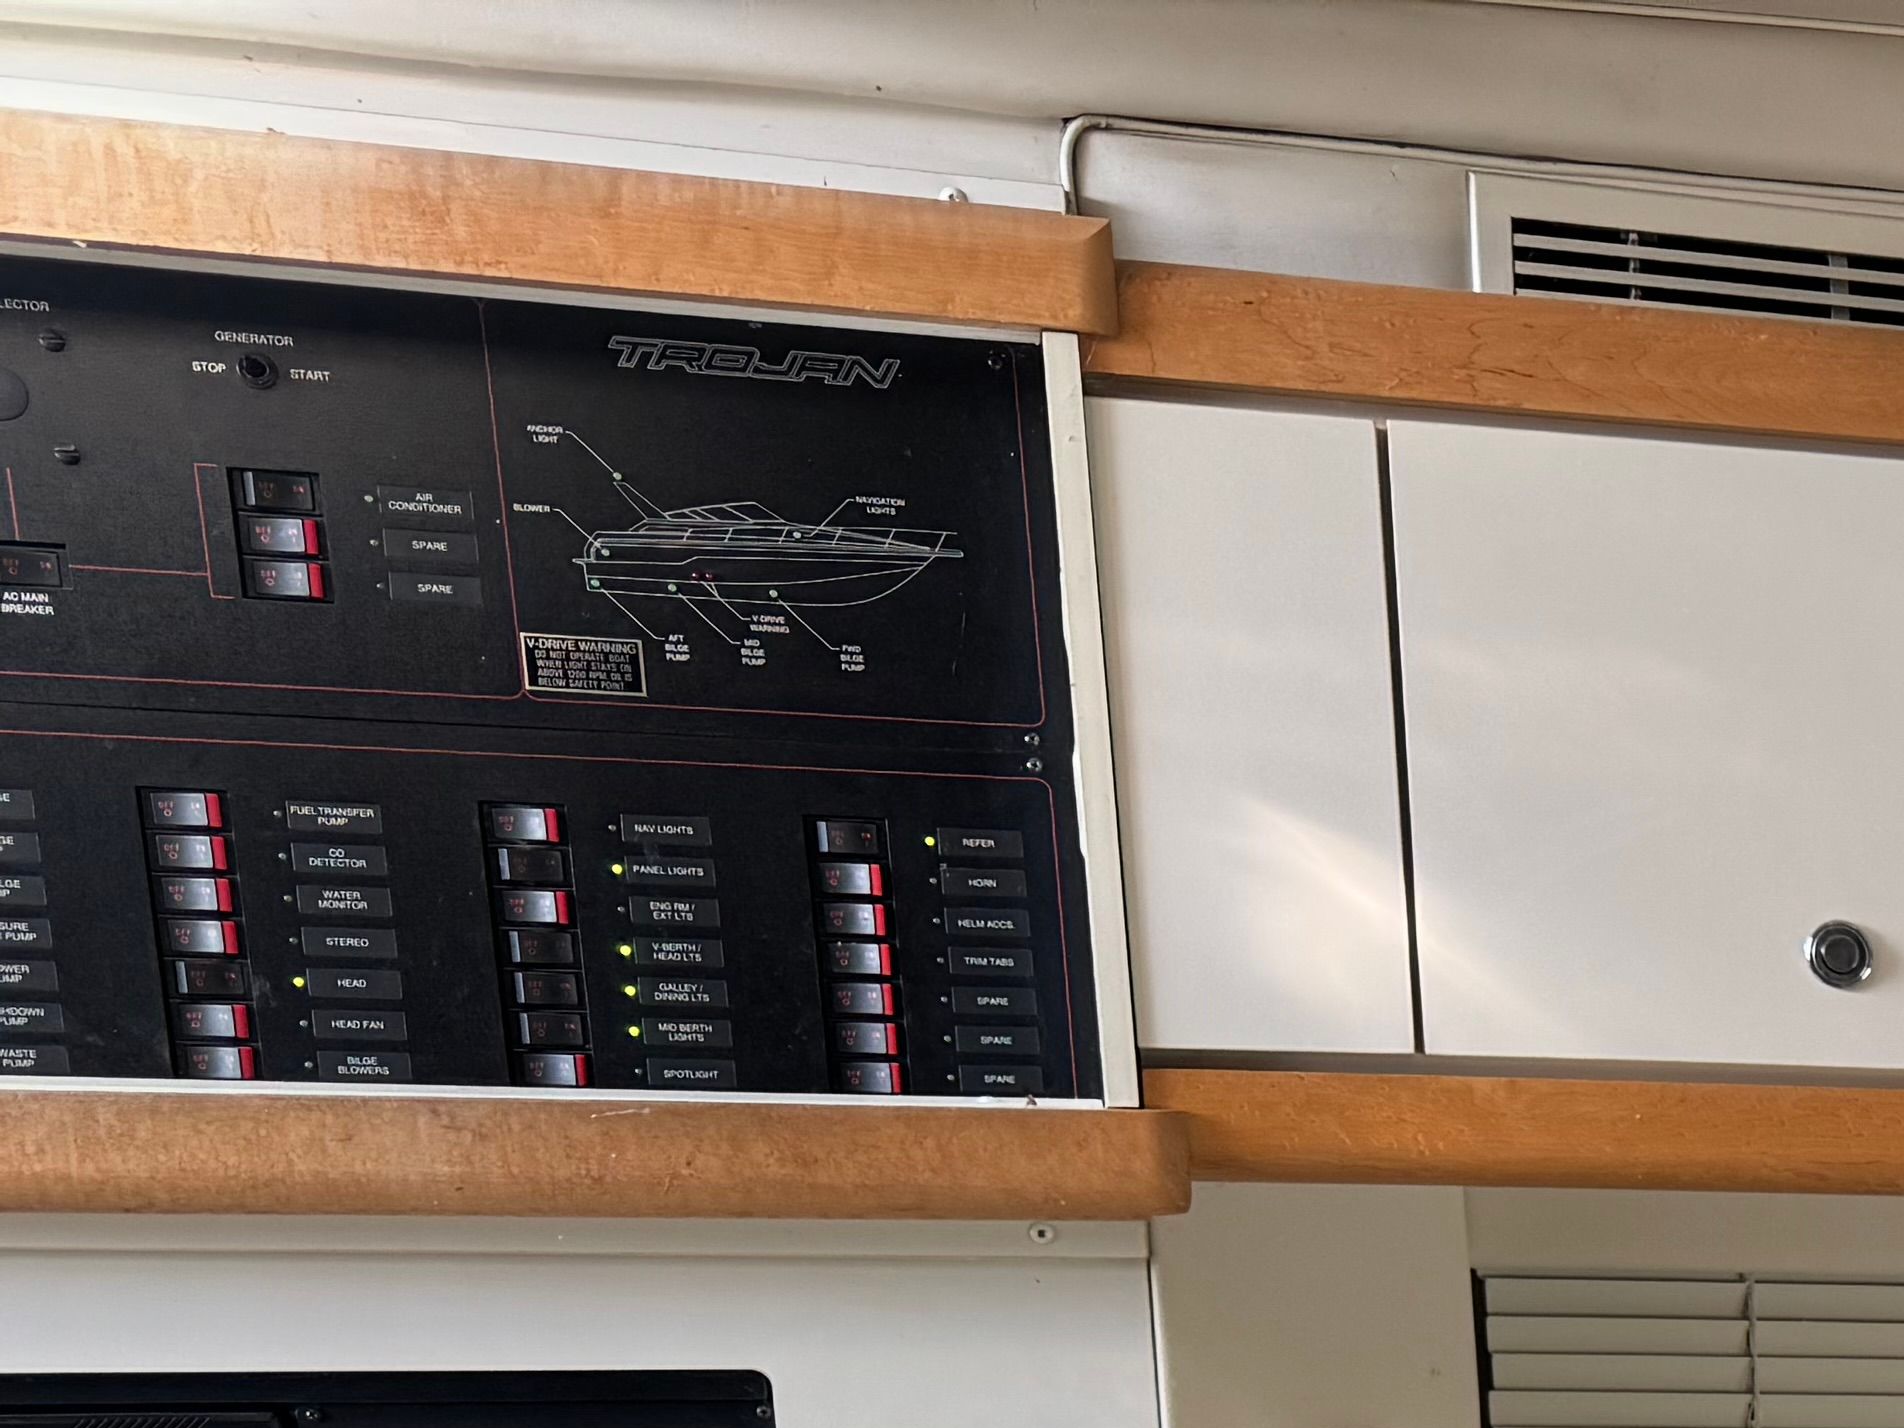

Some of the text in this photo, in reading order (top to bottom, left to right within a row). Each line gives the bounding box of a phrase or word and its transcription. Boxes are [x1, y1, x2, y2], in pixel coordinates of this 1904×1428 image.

[214, 330, 294, 347] GENERATOR
[608, 335, 900, 389] TROJAN
[192, 361, 330, 382] STOP START
[533, 434, 558, 443] LIGHT
[416, 492, 434, 502] AIR
[388, 501, 462, 514] CONDITIONER
[513, 503, 551, 513] BLOWER
[412, 540, 448, 551] SPARE
[417, 583, 453, 594] SPARE
[3, 592, 49, 603] AC MAIN
[1, 603, 54, 616] BREAKER
[668, 634, 684, 642] AFT
[526, 637, 637, 654] V-DRIVE WARNING
[664, 643, 689, 653] BILGE
[666, 652, 690, 662] PUMP
[740, 648, 765, 657] BILGE
[742, 656, 766, 666] PUMP
[840, 653, 865, 663] BILGE
[841, 662, 865, 672] PUMP
[290, 805, 375, 818] FUEL TRANSFER
[317, 816, 348, 826] PUMP
[634, 823, 694, 835] NAV LIGHTS
[962, 838, 996, 848] REFER
[329, 848, 345, 858] CO
[308, 857, 367, 869] DETECTOR
[632, 864, 704, 876] PANEL LIGHTS
[968, 879, 997, 888] HORN
[322, 889, 361, 900] WATER
[318, 900, 368, 910] MONITOR
[650, 901, 672, 911] ENG
[653, 911, 672, 920] EXT
[957, 919, 985, 928] HELM
[5, 932, 37, 942] PUMP
[325, 937, 369, 947] STEREO
[653, 952, 680, 961] HEAD
[963, 956, 1015, 967] TRIM TABS
[337, 978, 367, 988] HEAD
[659, 982, 698, 992] GALLEY
[654, 992, 689, 1002] DINING
[977, 997, 1009, 1006] SPARE
[331, 1019, 384, 1030] HEAD FAN
[658, 1022, 712, 1033] MID BERTH
[668, 1032, 705, 1042] LIGHTS
[980, 1035, 1013, 1045] SPARE
[3, 1058, 35, 1068] PUMP
[346, 1056, 378, 1065] BILGE
[337, 1065, 390, 1076] BLOWERS
[663, 1069, 719, 1080] SPOTLIGHT
[984, 1075, 1016, 1084] SPARE
